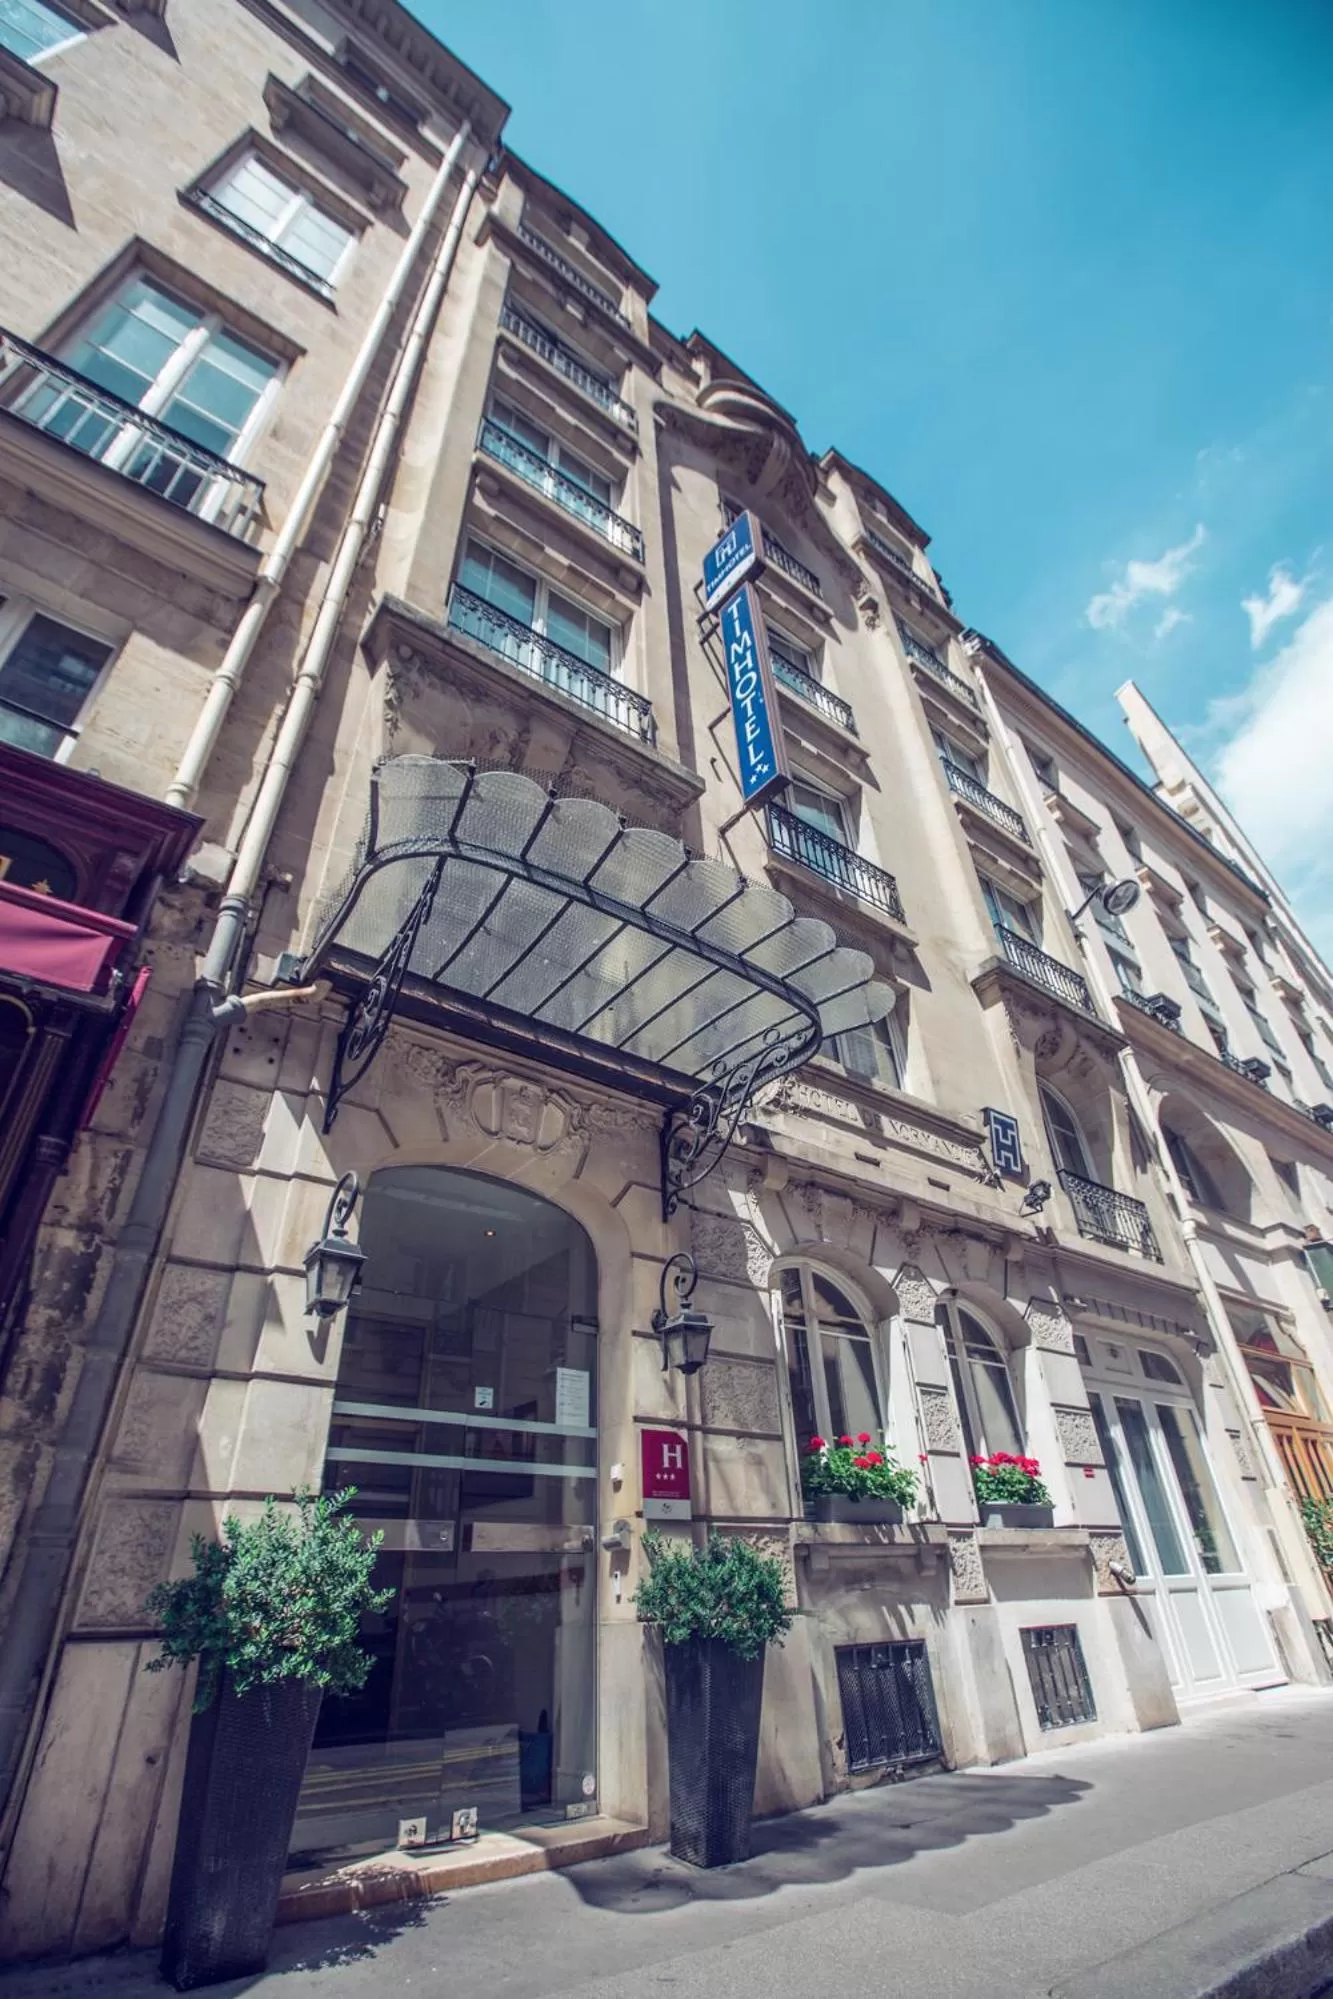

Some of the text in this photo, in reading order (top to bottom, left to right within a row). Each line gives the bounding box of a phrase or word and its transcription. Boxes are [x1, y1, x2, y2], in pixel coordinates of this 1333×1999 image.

[706, 543, 752, 593] TIMHOTEL
[727, 597, 764, 765] TIMHOTEL
[662, 1443, 684, 1469] H
